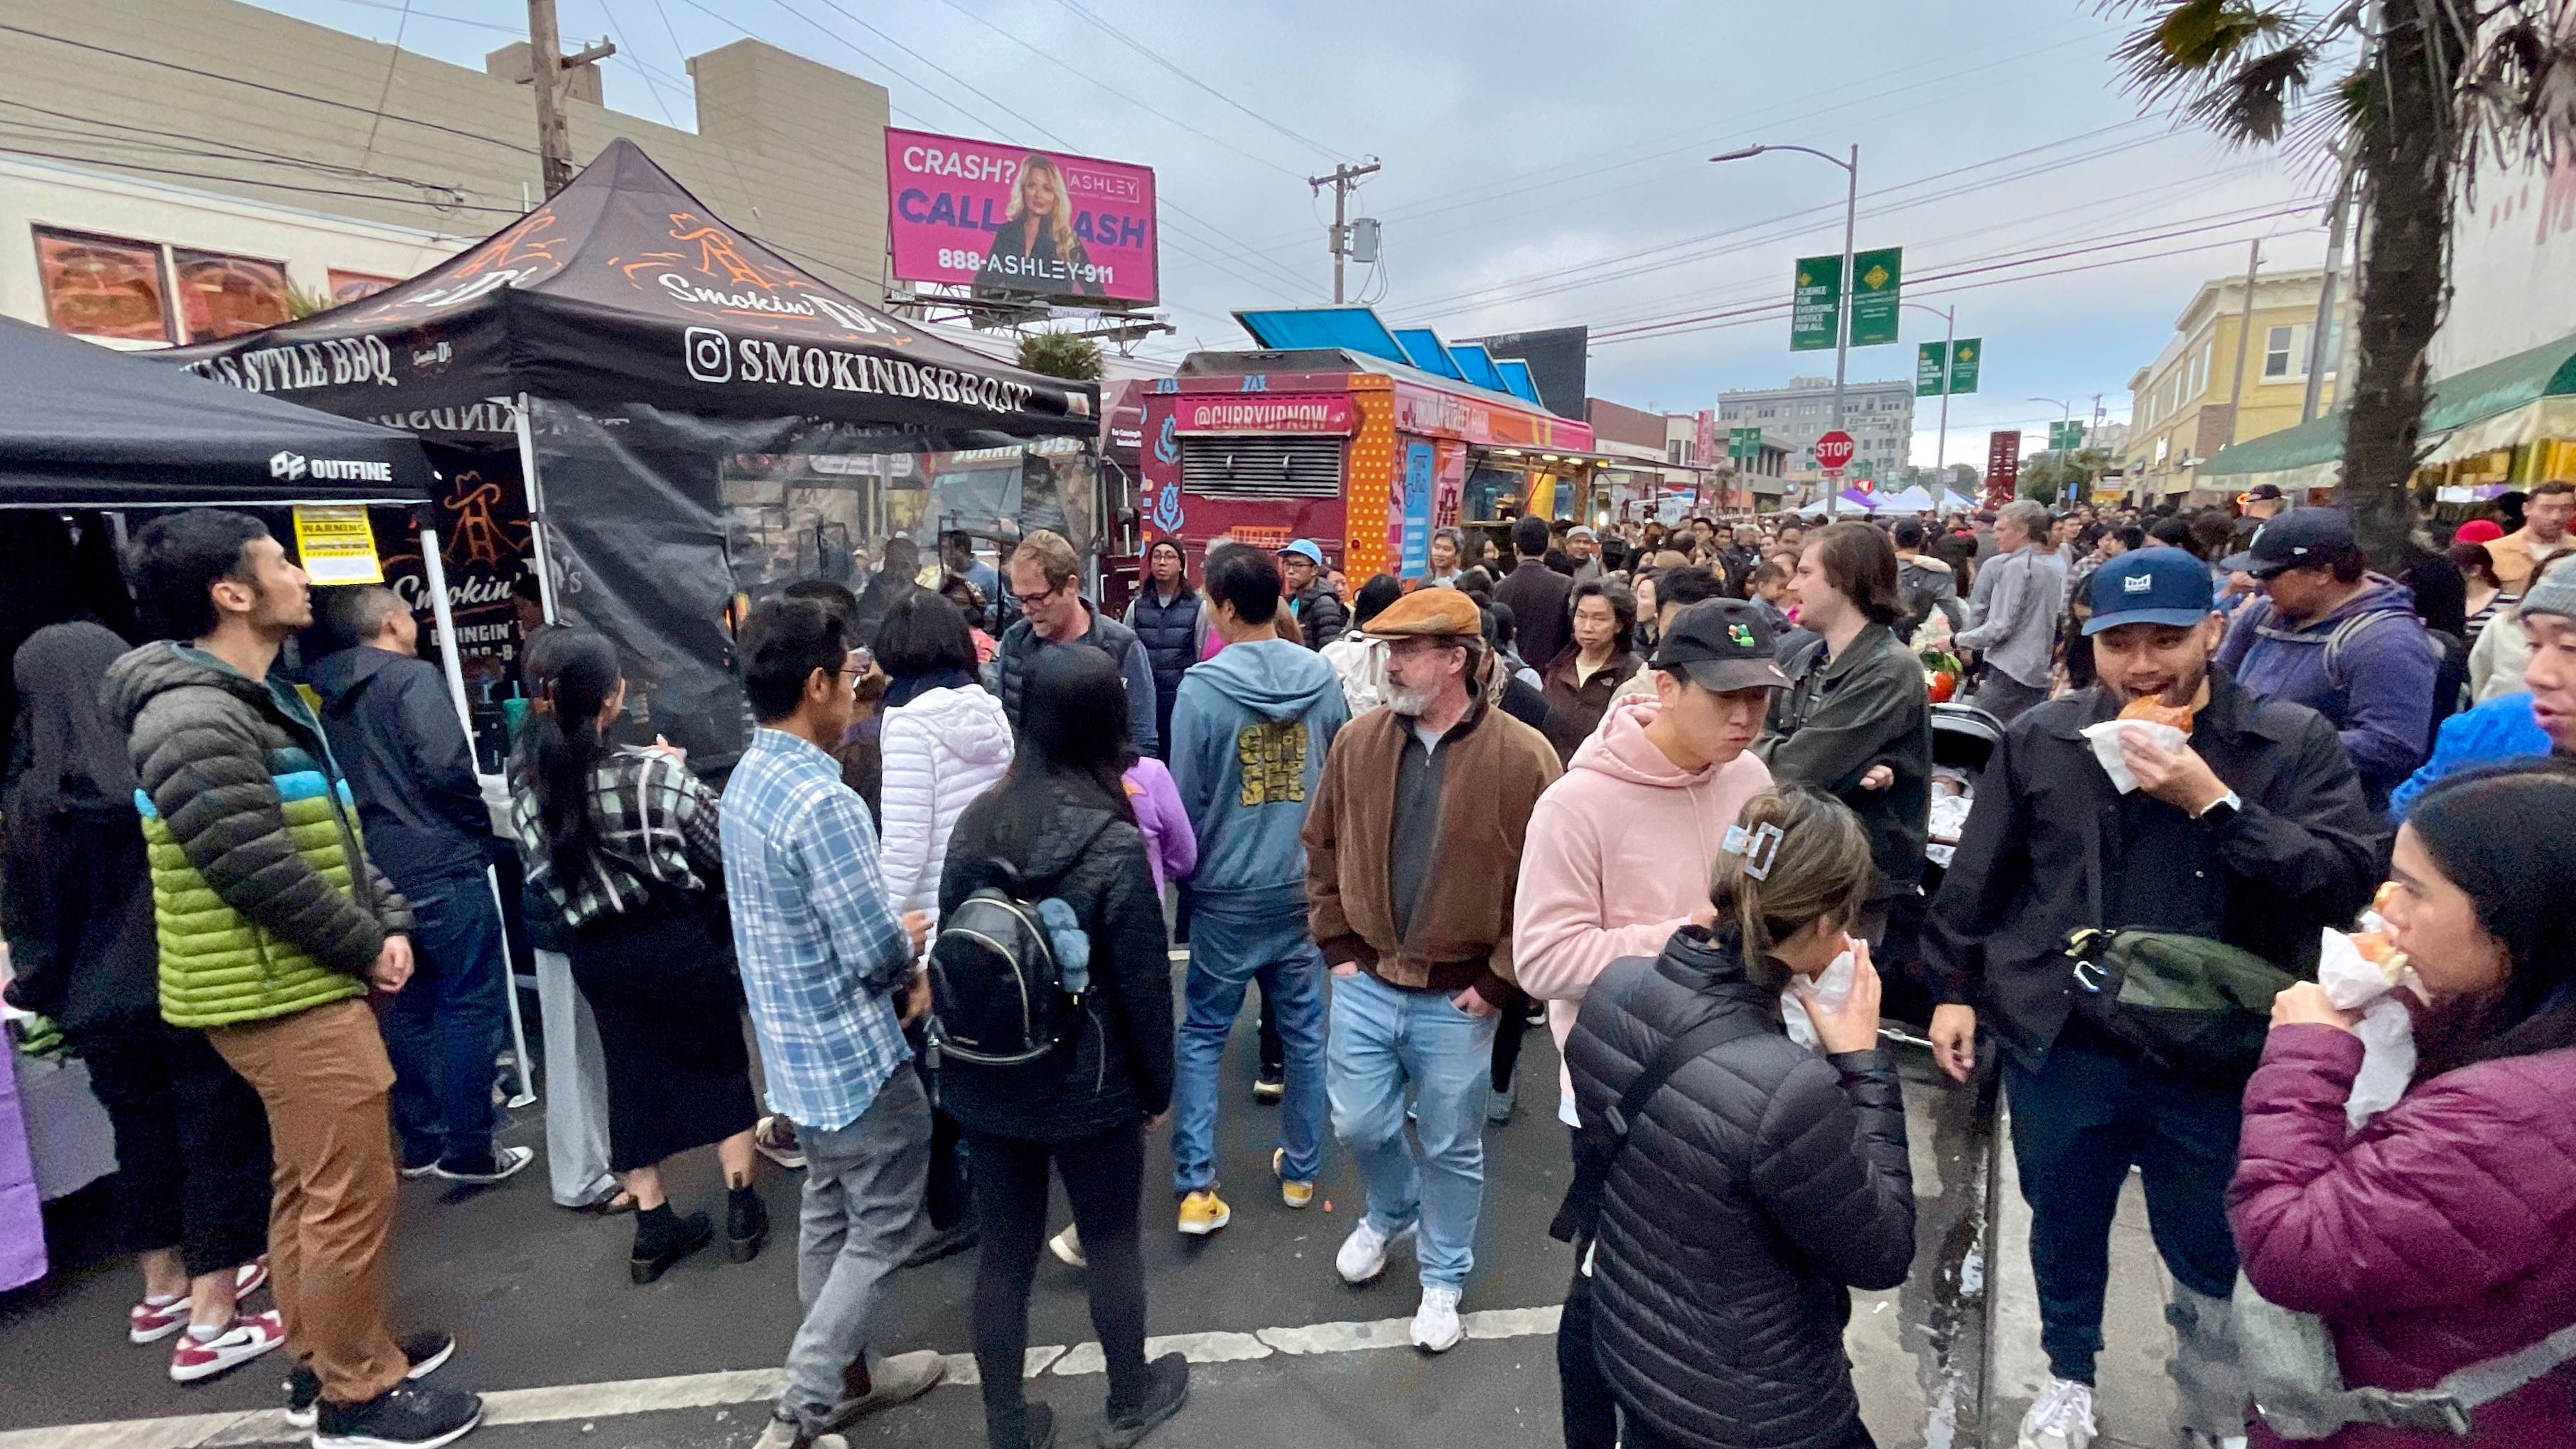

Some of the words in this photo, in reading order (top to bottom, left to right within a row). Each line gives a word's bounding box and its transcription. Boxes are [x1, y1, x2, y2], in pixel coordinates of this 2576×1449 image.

[904, 146, 1016, 185] CRASH?
[1069, 174, 1136, 195] ASHLEY
[898, 188, 1004, 233] CALL
[1073, 210, 1147, 249] ASH
[937, 247, 1114, 284] 888-ASHLEY-911
[658, 273, 815, 316] Smokin'
[800, 293, 898, 334] D's
[242, 343, 328, 394] STYLE
[323, 334, 398, 387] BBQ
[1194, 405, 1328, 431] @CURRYUPNOW
[1816, 441, 1853, 458] STOP
[311, 459, 392, 482] OUTFINE
[302, 524, 367, 533] WARNING
